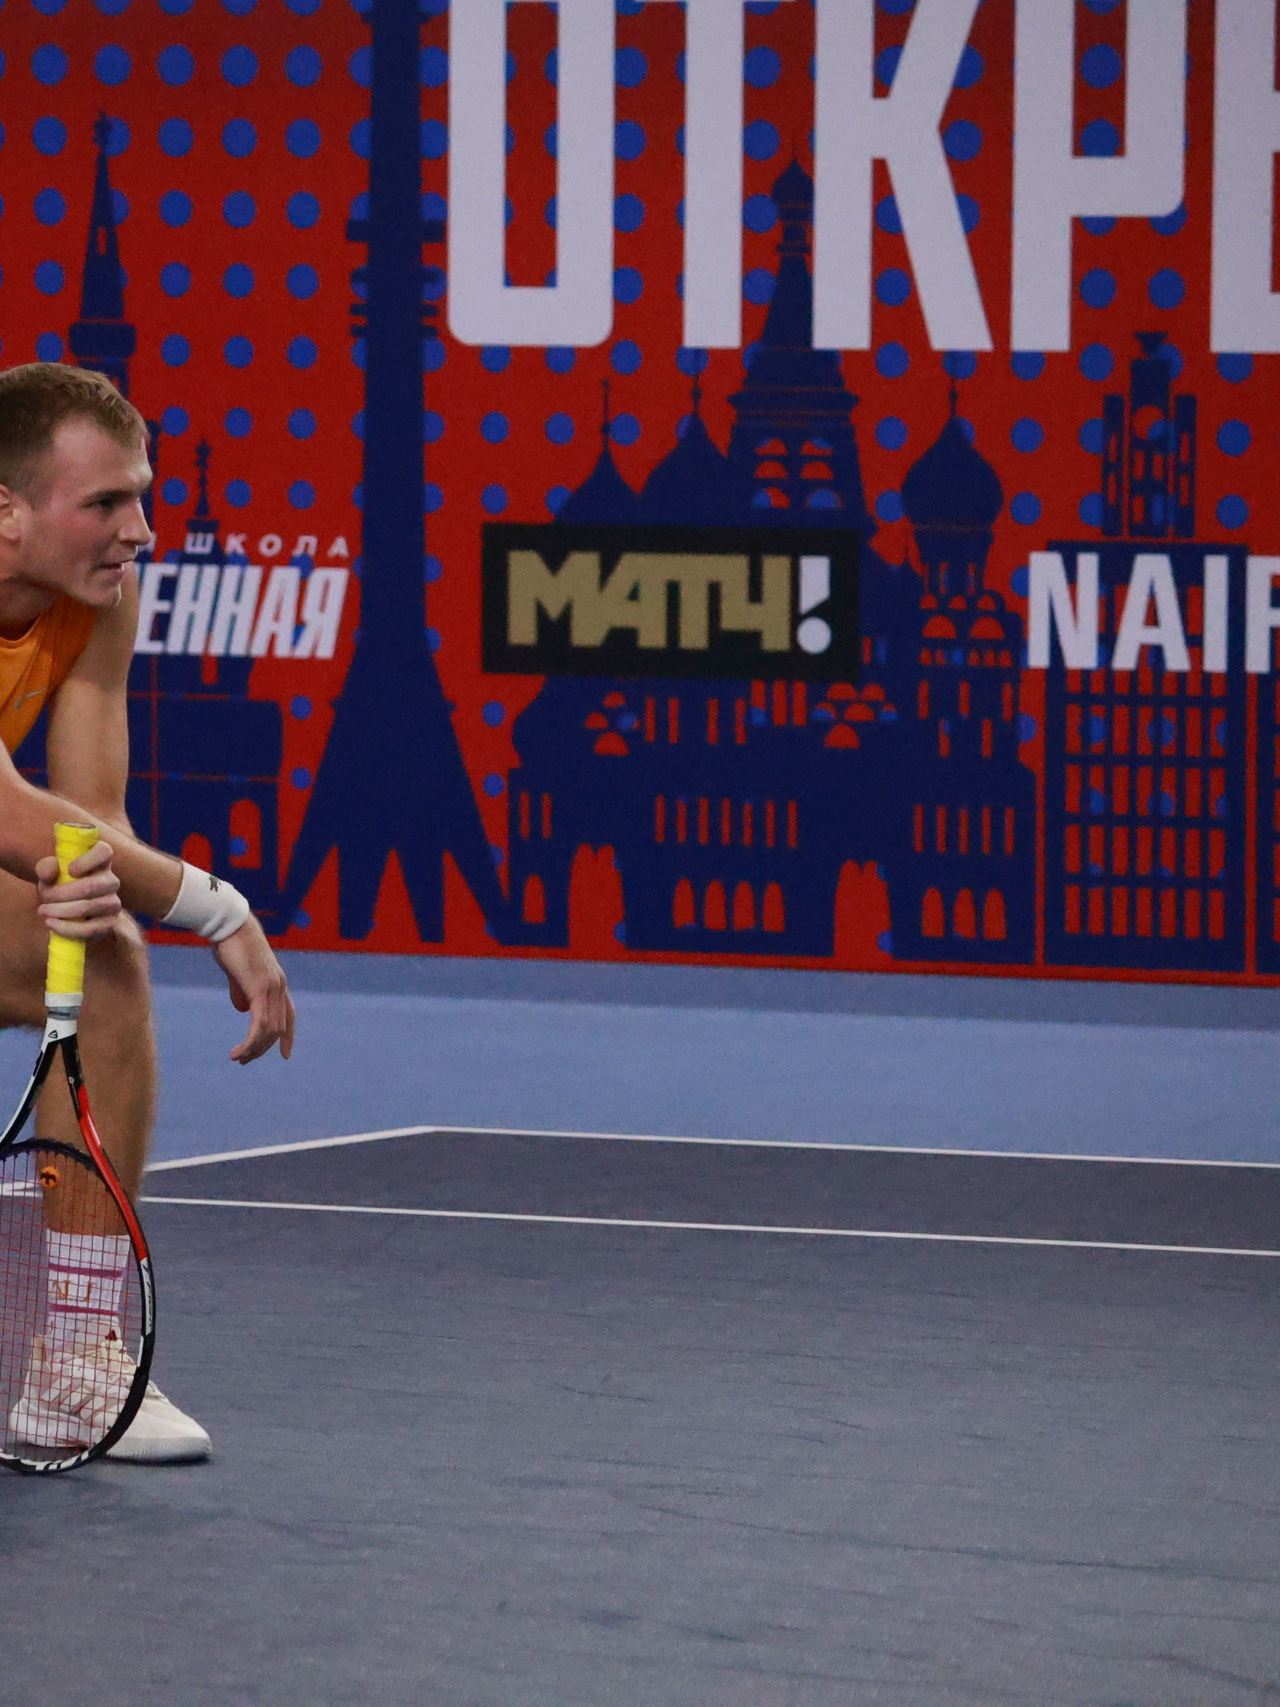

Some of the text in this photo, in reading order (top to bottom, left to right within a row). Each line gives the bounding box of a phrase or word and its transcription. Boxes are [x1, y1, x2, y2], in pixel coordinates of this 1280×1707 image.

[184, 532, 350, 558] ШКОЛА
[133, 562, 350, 660] ЕННАЯ
[507, 549, 832, 655] МАТЧ!
